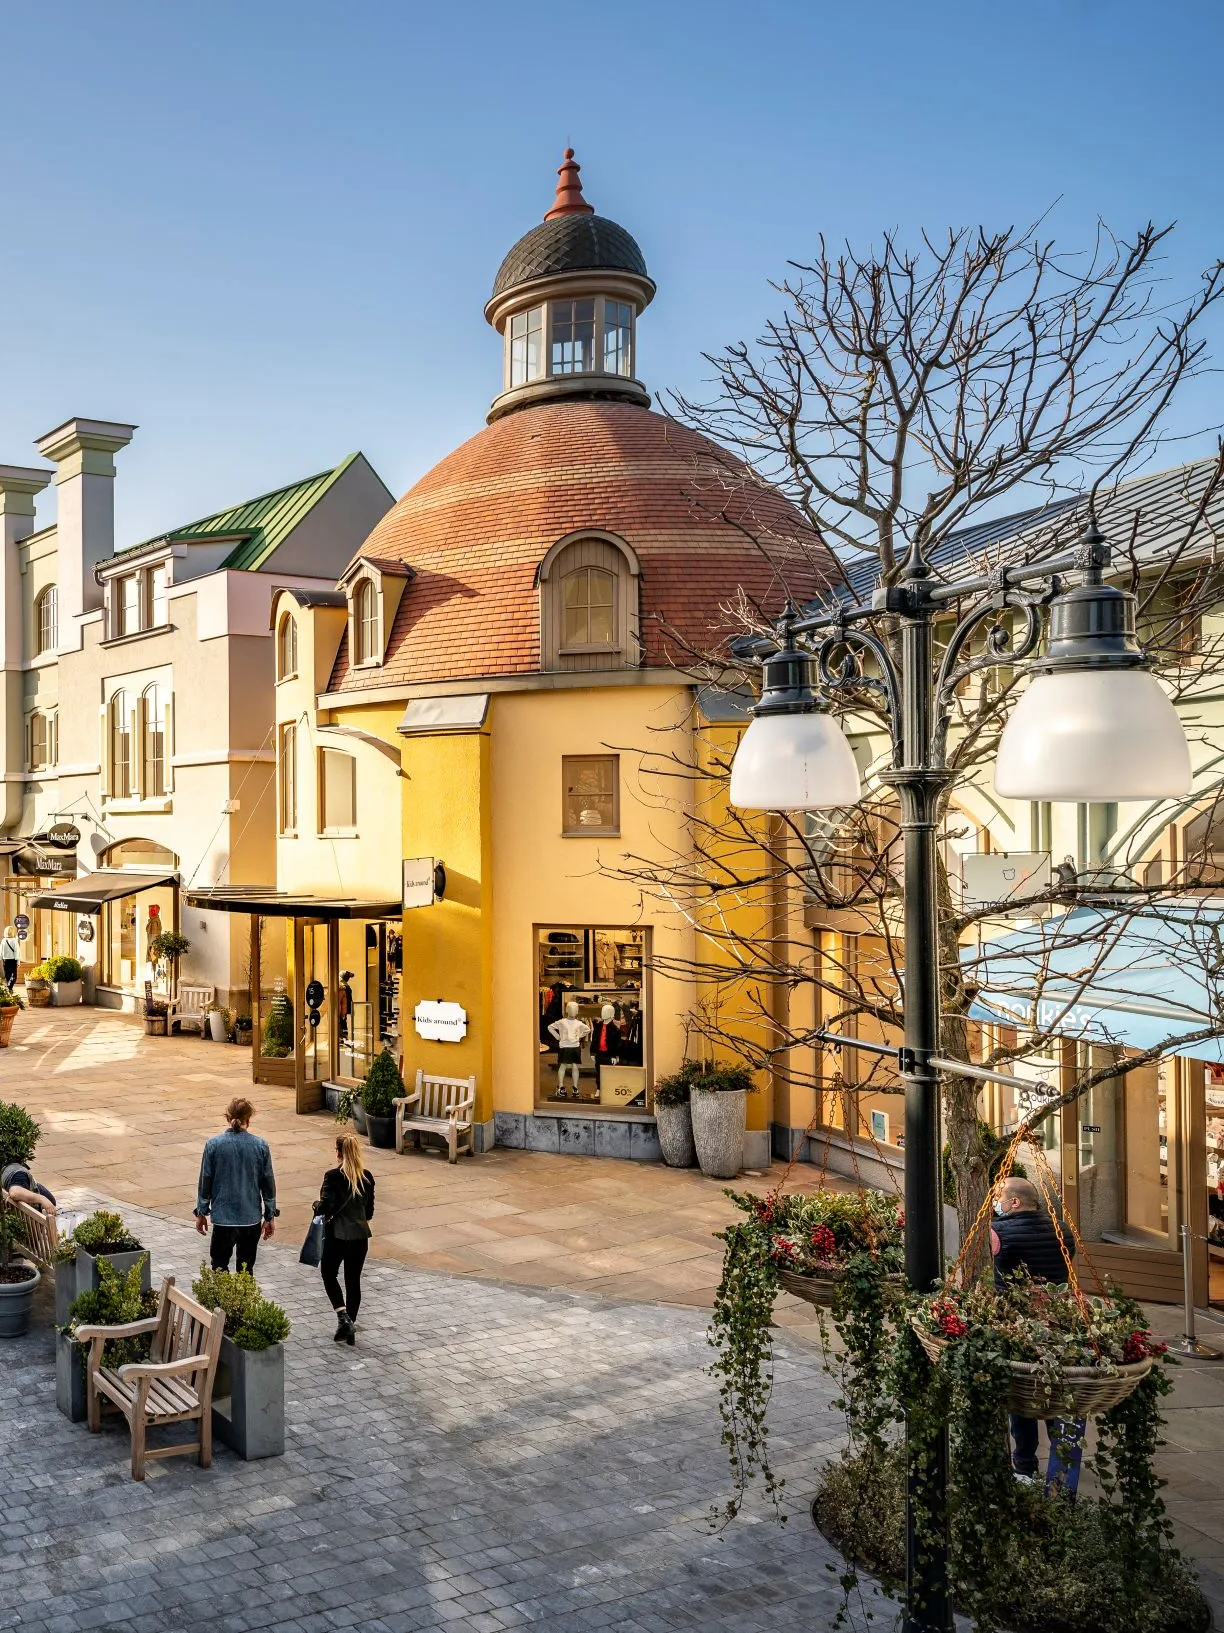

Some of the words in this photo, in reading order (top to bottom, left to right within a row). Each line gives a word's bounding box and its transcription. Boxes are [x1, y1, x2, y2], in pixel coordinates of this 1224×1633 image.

[50, 832, 79, 841] MaxMara
[36, 856, 63, 871] MaxMara
[417, 1016, 433, 1024] Kids
